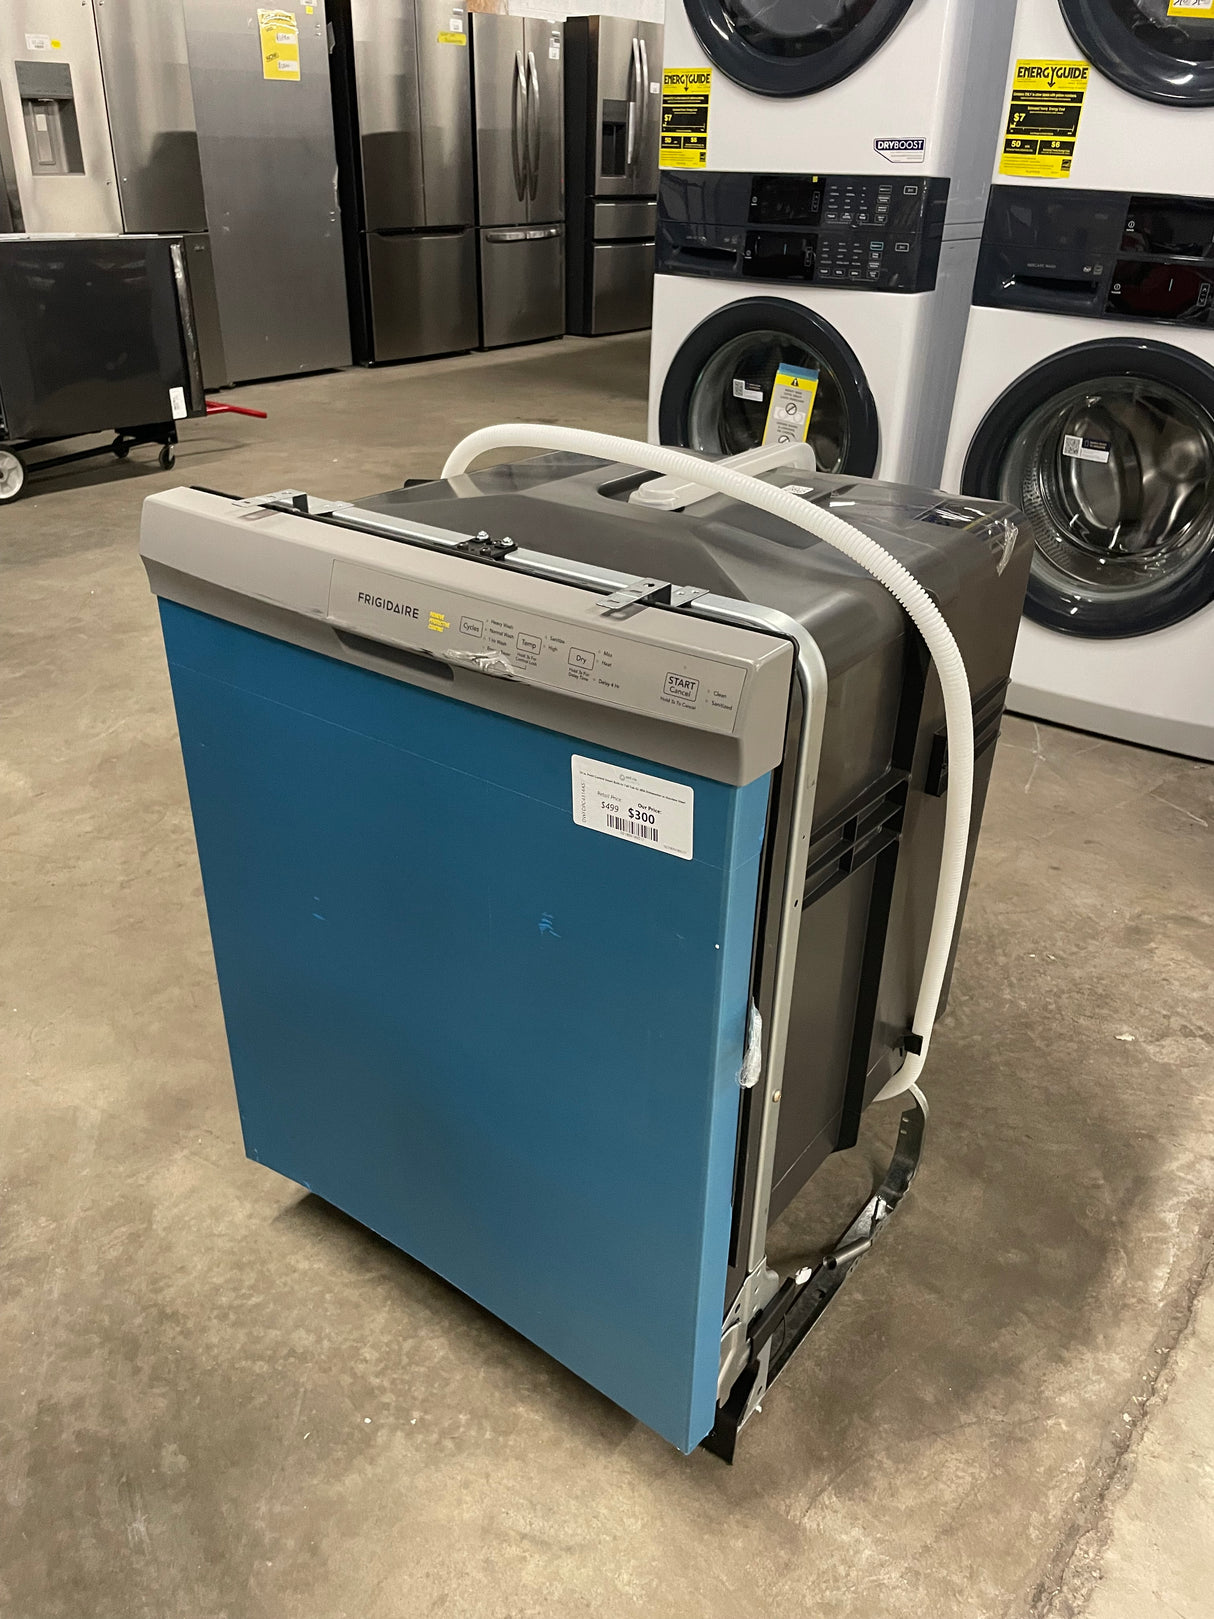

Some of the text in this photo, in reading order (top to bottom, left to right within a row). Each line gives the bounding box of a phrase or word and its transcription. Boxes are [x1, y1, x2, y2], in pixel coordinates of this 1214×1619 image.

[1013, 113, 1026, 122] $7
[877, 140, 923, 150] DRYBOOST
[358, 591, 420, 619] FRIGIDAIRE
[463, 622, 480, 632] Cycles
[521, 638, 537, 650] Temp
[575, 654, 587, 665] Dry
[668, 676, 696, 690] START
[669, 686, 692, 698] Cancel
[713, 690, 727, 699] Clean
[711, 700, 733, 711] Sanitized
[601, 801, 619, 813] $499
[637, 803, 648, 811] Our
[628, 807, 655, 825] $300
